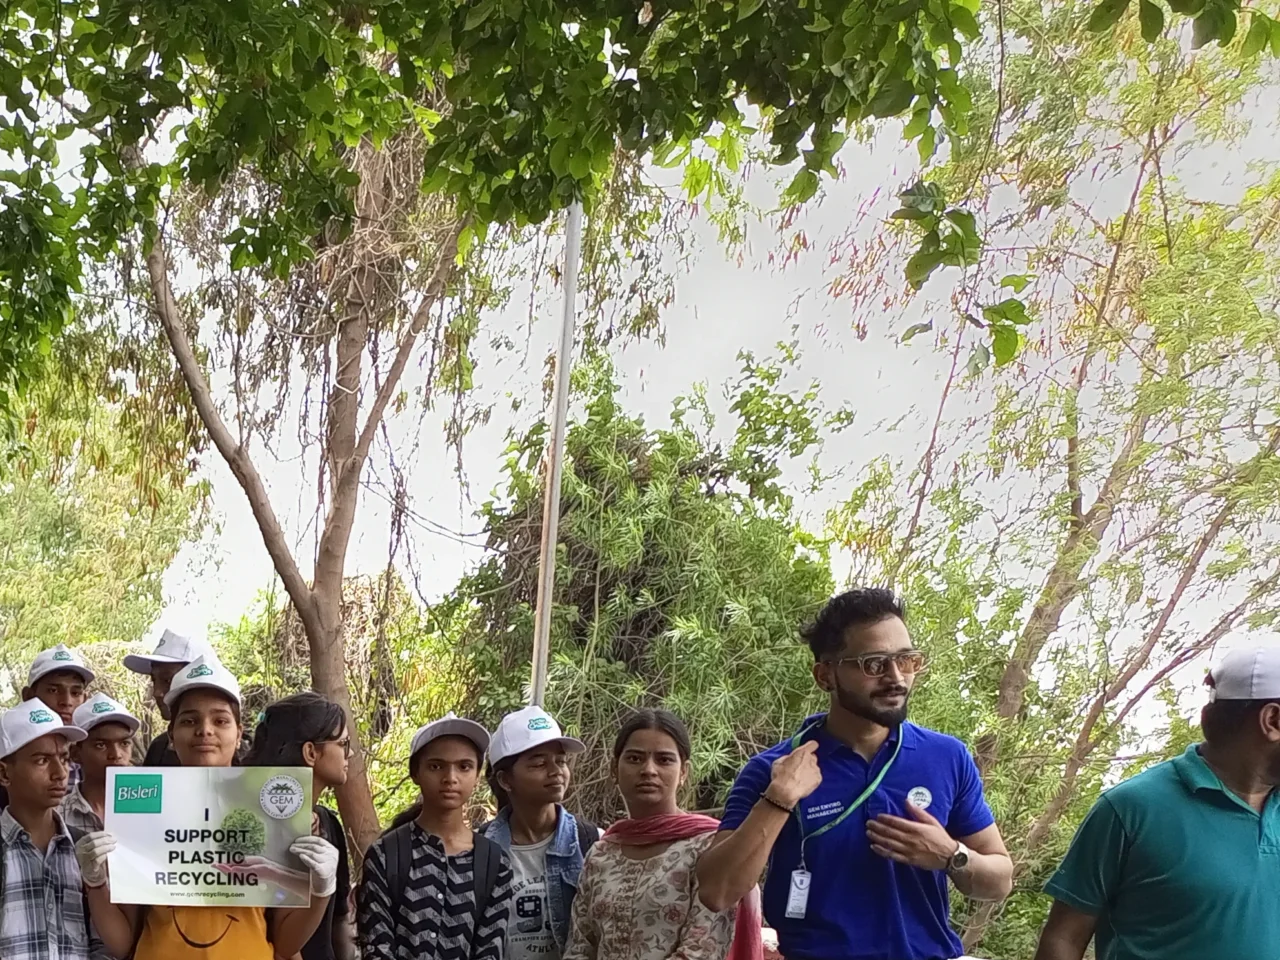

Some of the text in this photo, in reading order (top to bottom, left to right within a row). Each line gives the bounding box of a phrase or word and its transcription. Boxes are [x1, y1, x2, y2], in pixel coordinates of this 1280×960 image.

[117, 785, 158, 801] Bisleri
[270, 795, 294, 804] GEM
[204, 808, 209, 821] I
[164, 829, 249, 844] SUPPORT
[169, 850, 245, 865] PLASTIC
[155, 871, 259, 886] RECYCLING
